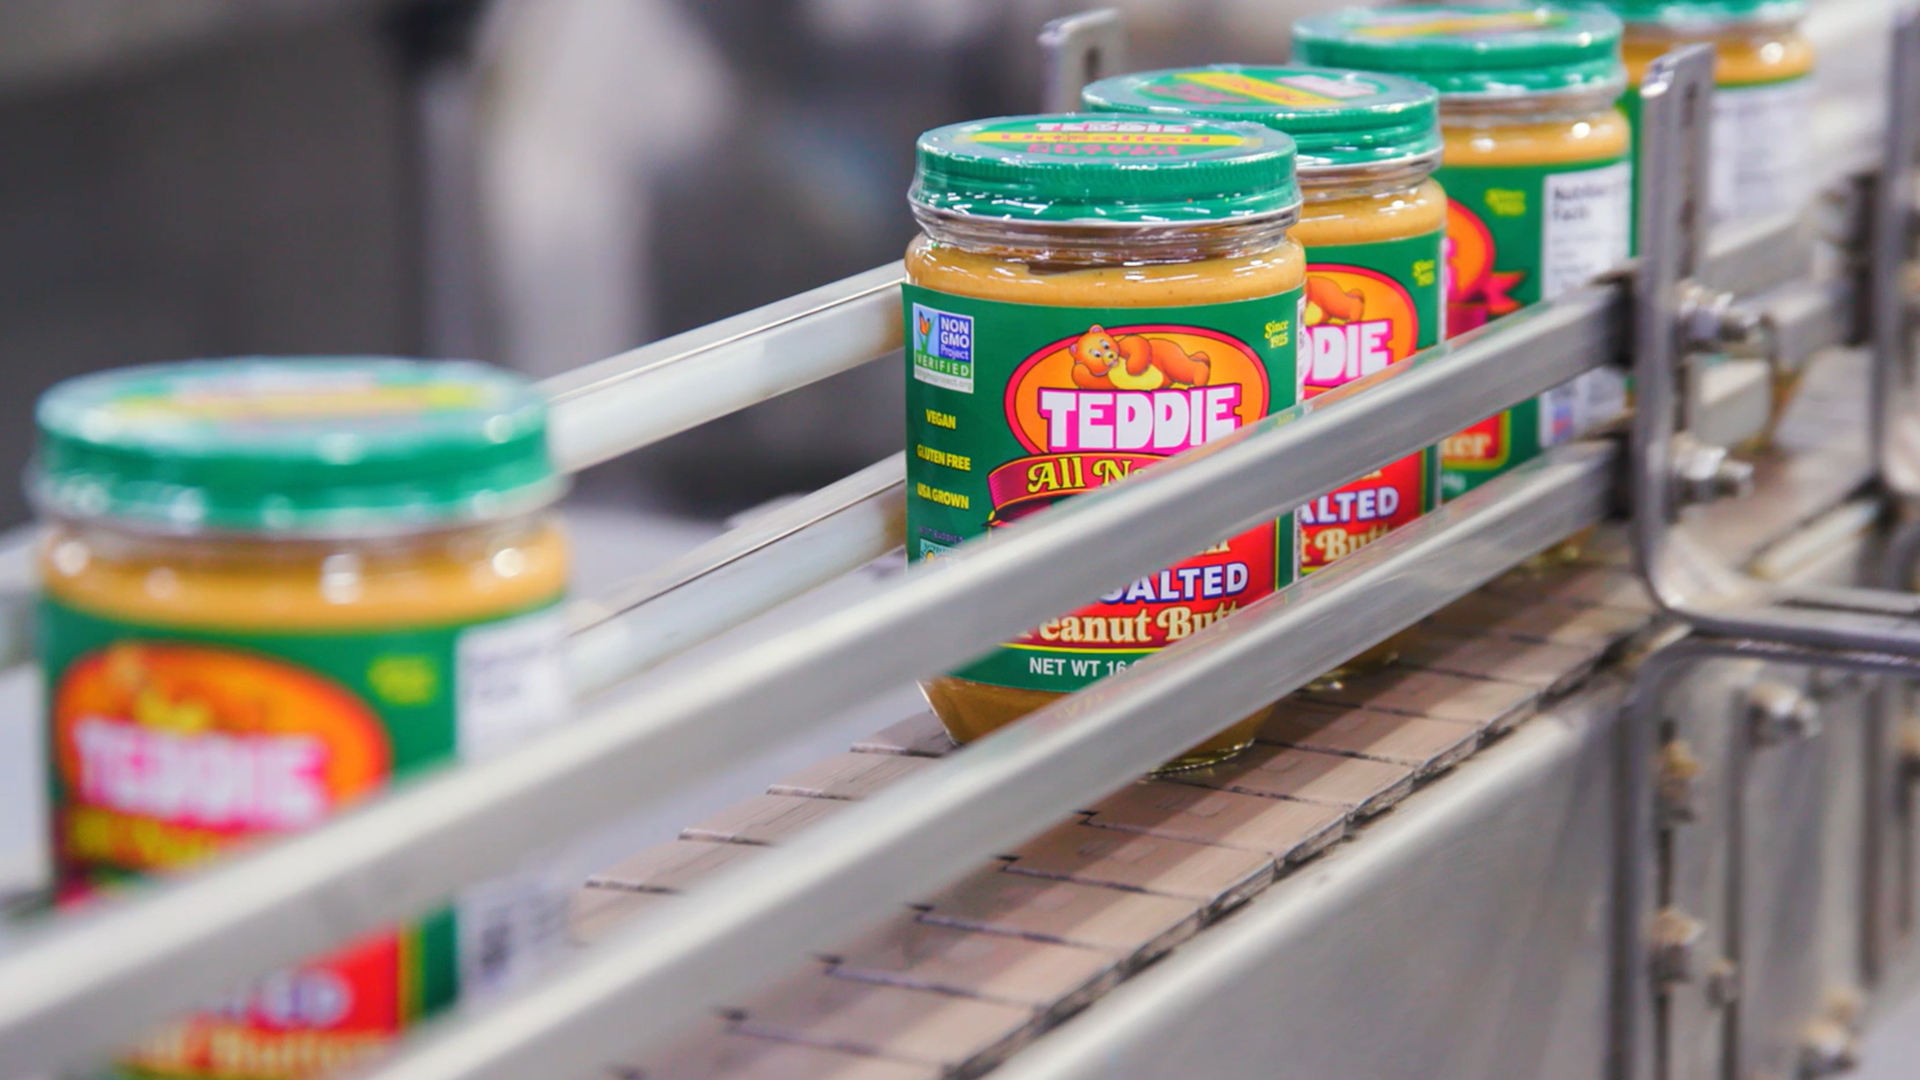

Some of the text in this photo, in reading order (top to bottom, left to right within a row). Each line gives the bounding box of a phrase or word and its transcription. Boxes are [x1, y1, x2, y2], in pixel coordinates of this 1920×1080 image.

[940, 316, 969, 335] NON
[940, 330, 970, 349] GMO
[1264, 320, 1289, 339] Since
[916, 351, 970, 377] VERIFIED
[940, 344, 969, 361] Project
[1303, 320, 1391, 382] DIE
[925, 408, 957, 430] VEGAN
[1039, 385, 1239, 450] TEDDIE
[916, 443, 971, 472] GLUTEN FREE
[1027, 456, 1086, 493] All
[916, 482, 970, 510] USA GROWN
[1301, 486, 1399, 524] ALTED
[1100, 562, 1249, 602] ALTED
[1017, 607, 1152, 643] eanut
[1029, 656, 1066, 676] NET
[1071, 659, 1101, 677] WT
